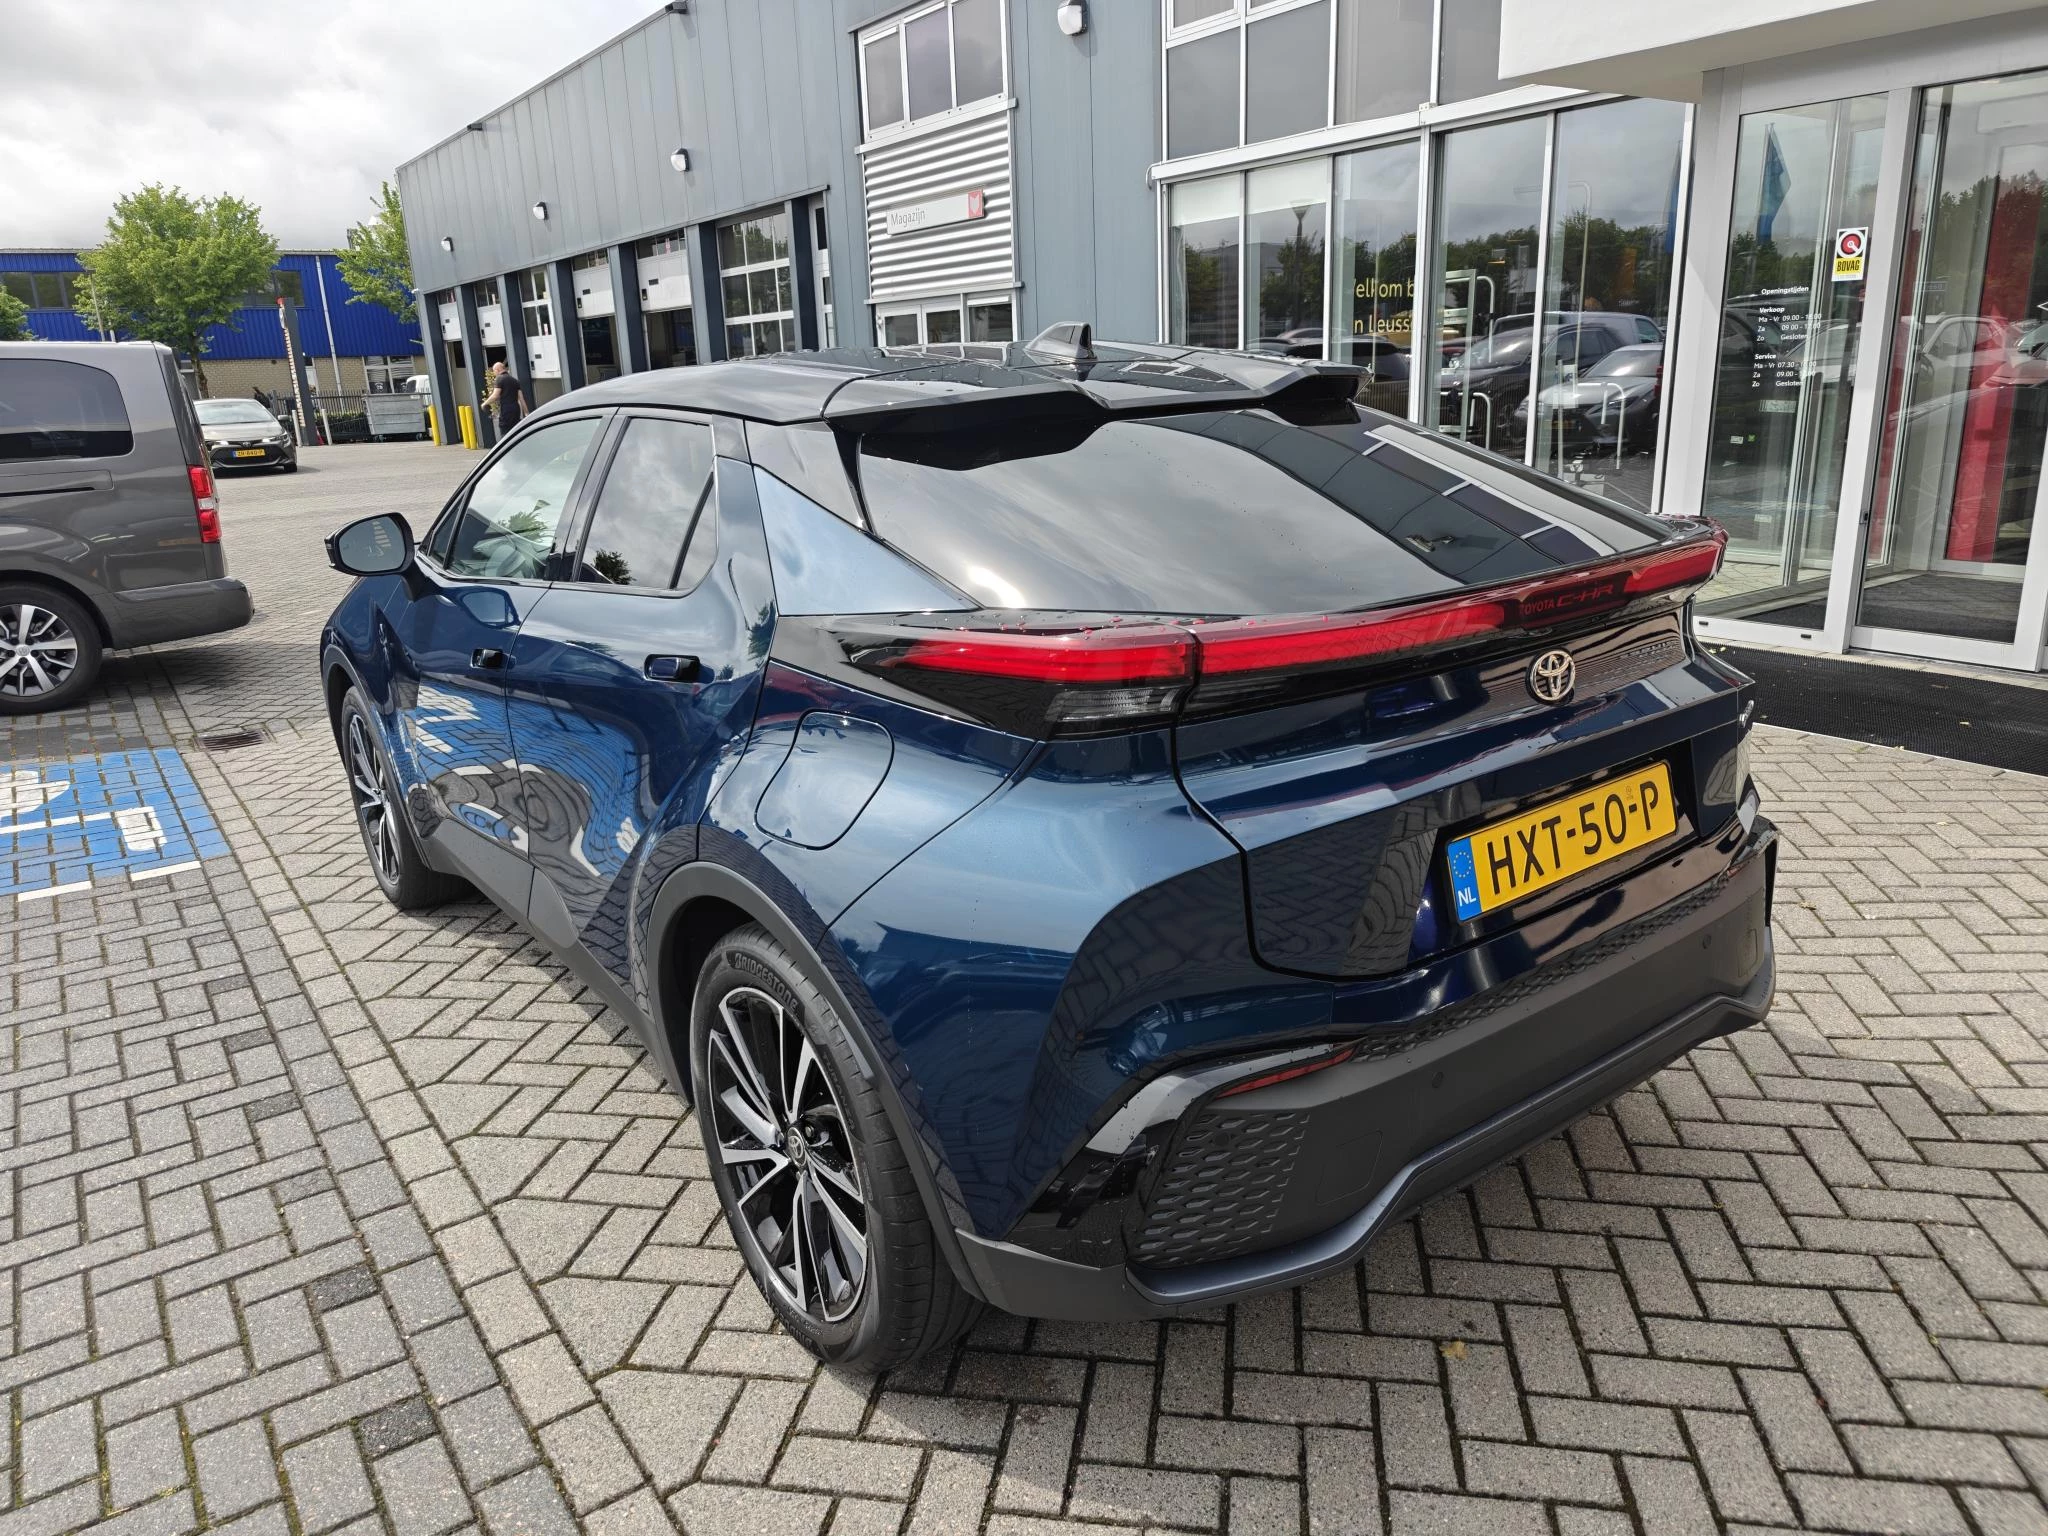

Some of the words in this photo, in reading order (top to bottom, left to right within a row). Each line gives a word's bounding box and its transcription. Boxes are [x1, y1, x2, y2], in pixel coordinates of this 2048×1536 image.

[890, 208, 926, 228] Magazijn
[1837, 260, 1860, 272] BOVAG
[1354, 278, 1403, 298] elkom
[1761, 286, 1809, 295] Openingstijden
[1780, 333, 1808, 341] Gesloten
[1519, 599, 1555, 616] TOYOTA
[1487, 780, 1659, 896] HXT-50-P
[1457, 886, 1477, 908] NL
